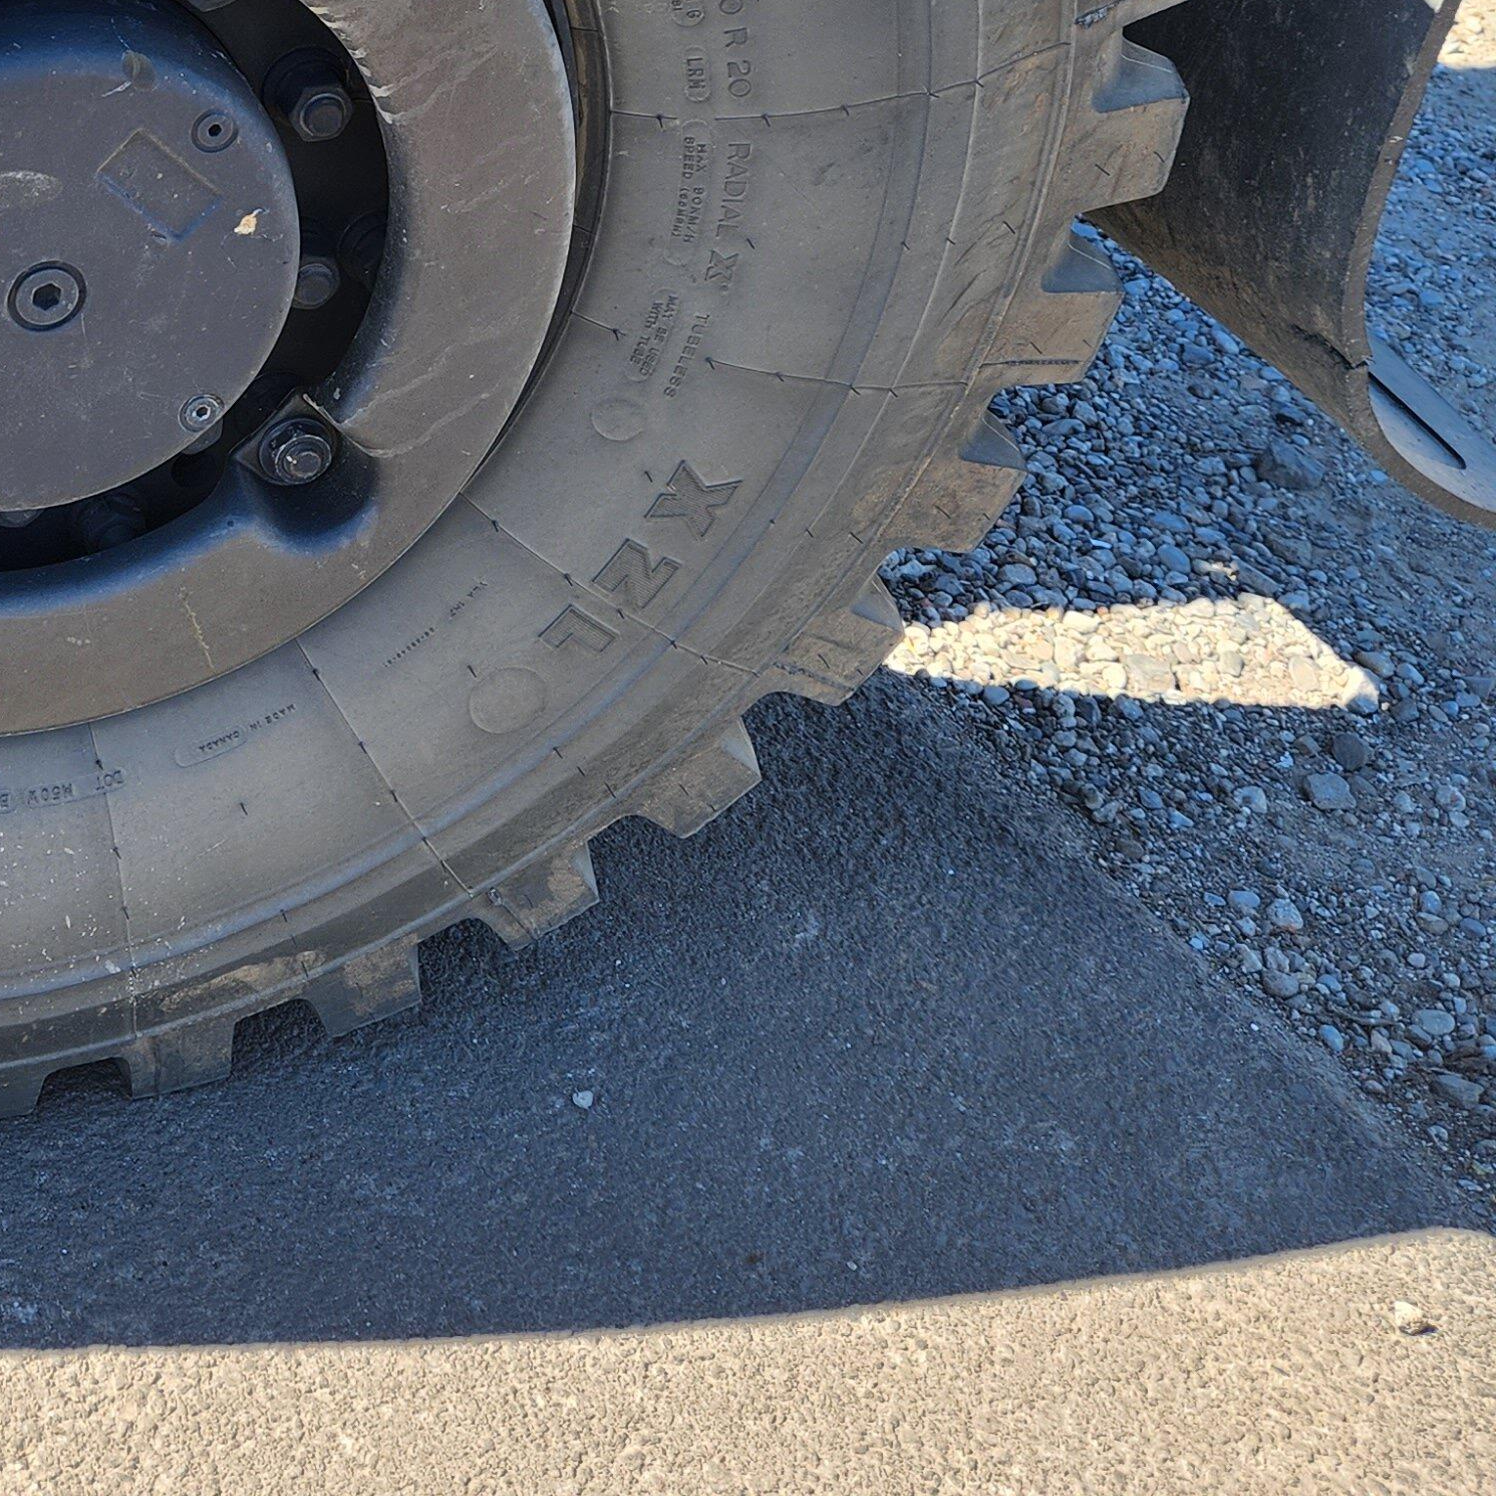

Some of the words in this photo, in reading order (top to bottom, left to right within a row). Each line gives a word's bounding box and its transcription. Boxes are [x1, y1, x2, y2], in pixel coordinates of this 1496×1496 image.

[723, 26, 749, 48] R
[685, 56, 705, 89] LRM
[726, 58, 752, 98] 20
[679, 135, 696, 180] SPEED
[693, 142, 708, 173] MAX
[714, 141, 750, 242] RADIAL
[642, 299, 664, 331] WITH
[662, 294, 681, 321] MAY
[628, 332, 652, 366] TUBE
[653, 325, 670, 344] BE
[637, 345, 661, 379] USED
[661, 309, 711, 402] TUBELESS
[536, 458, 744, 654] XZL
[262, 703, 297, 724] MADE
[196, 728, 241, 754] CANADA
[91, 768, 125, 791] DOT
